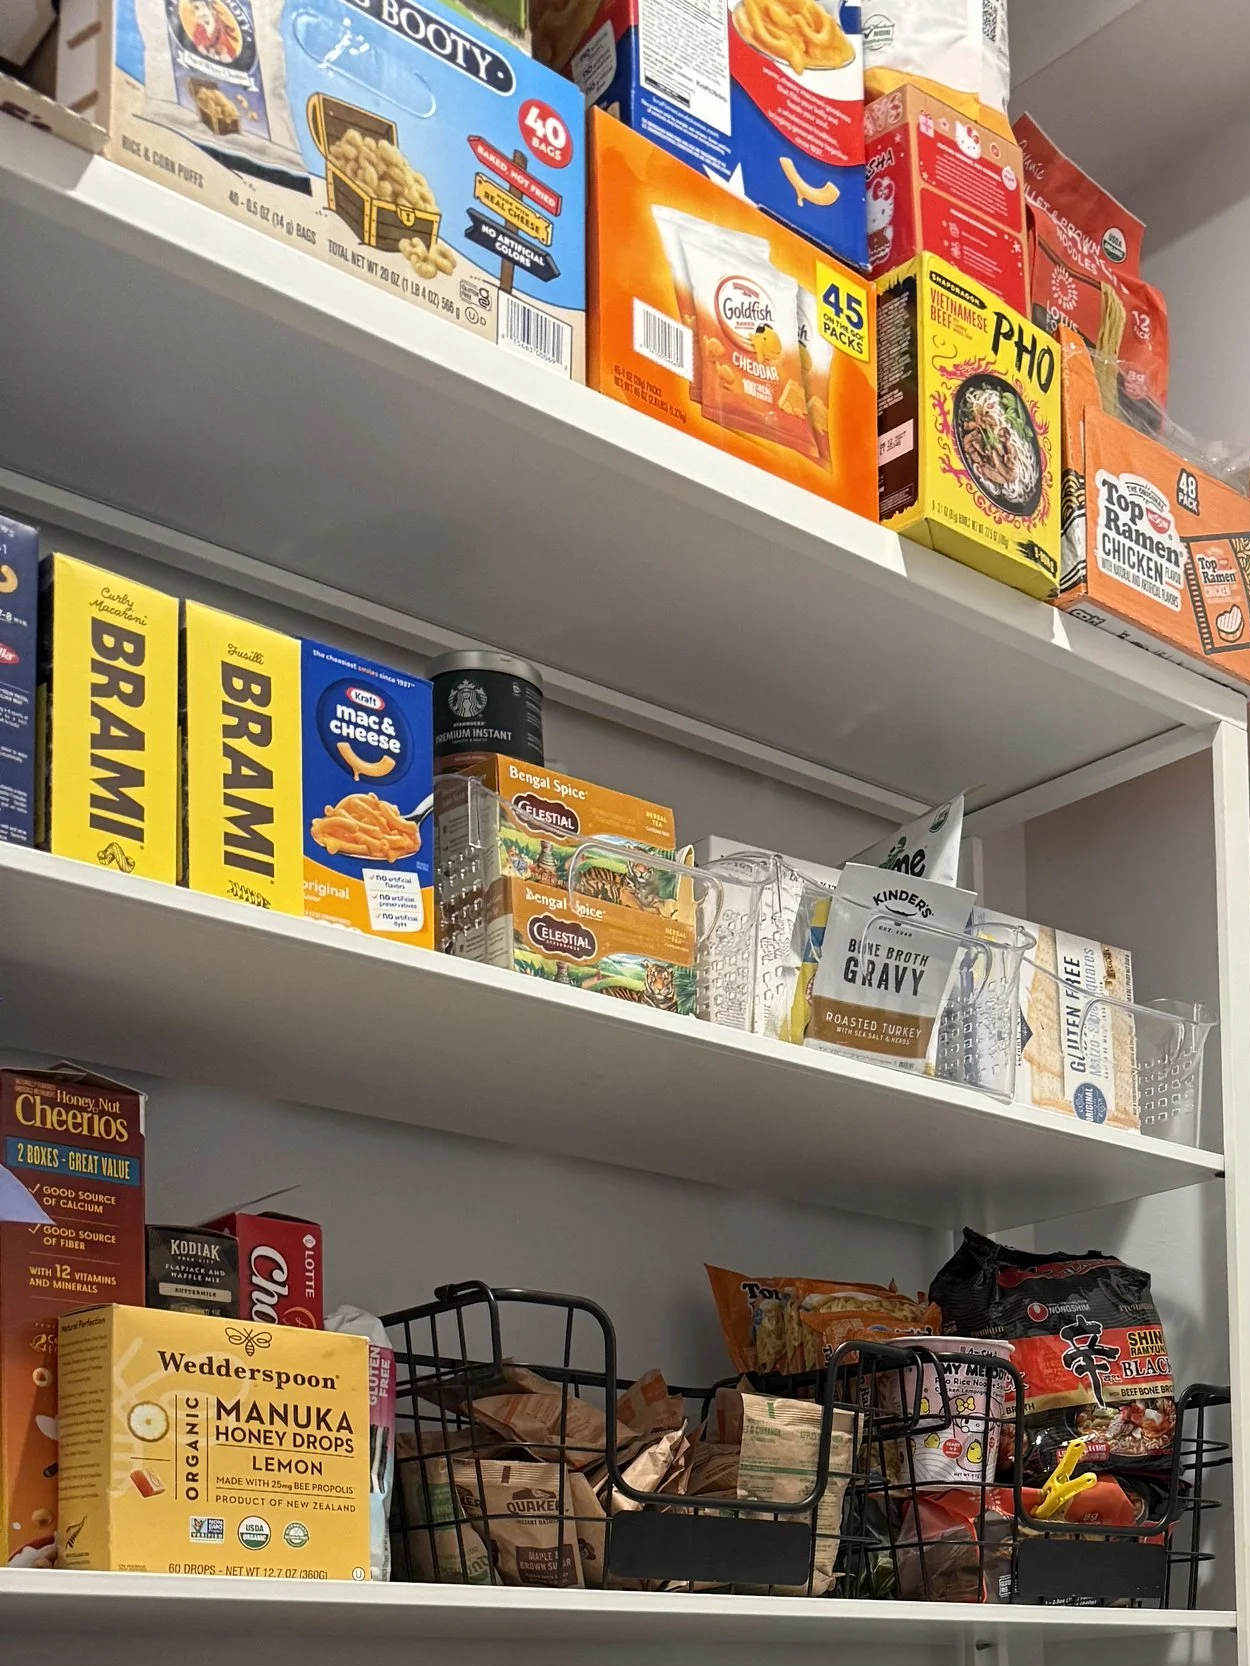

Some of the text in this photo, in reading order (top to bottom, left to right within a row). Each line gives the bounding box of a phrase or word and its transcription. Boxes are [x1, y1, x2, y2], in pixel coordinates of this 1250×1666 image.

[382, 2, 489, 84] BOOTY
[525, 105, 566, 149] 40
[122, 135, 142, 155] RICE
[153, 153, 176, 175] CORN
[178, 165, 204, 189] PUFFS
[532, 136, 561, 161] BAGS
[495, 242, 531, 267] COLORS
[1056, 227, 1097, 275] NOODLES
[723, 298, 774, 323] Goldfish
[823, 283, 864, 331] 45
[930, 288, 988, 333] VIETNAMESE
[930, 304, 952, 329] BEEF
[824, 324, 863, 355] PACKS
[993, 312, 1054, 394] PHO
[732, 352, 779, 381] CHEDDAR
[1179, 472, 1197, 499] 48
[1102, 479, 1144, 526] Top
[1178, 493, 1199, 513] PACK
[1104, 505, 1180, 568] Ramen
[1101, 532, 1182, 586] CHICKEN FLAVOR
[1198, 557, 1218, 572] Top
[1202, 570, 1236, 584] Ramen
[355, 691, 377, 707] Kraft
[89, 616, 146, 842] BRAMI
[336, 704, 396, 735] mac &
[472, 728, 512, 741] INSTANT
[220, 659, 275, 878] BRAMI
[509, 766, 586, 799] Bengal Spice
[873, 889, 933, 919] KINDER'S
[532, 922, 591, 950] CELESTIAL
[887, 947, 929, 966] BROTH
[844, 957, 925, 996] GRAVY
[826, 1011, 922, 1039] ROASTED TURKEY
[56, 1090, 121, 1113] Honey Nut
[15, 1093, 129, 1142] Cheerios
[17, 1143, 130, 1180] 2 BOXES GREAT VALUE
[43, 1186, 117, 1205] GOOD SOURCE
[43, 1196, 103, 1214] OF CALCIUM
[43, 1226, 117, 1244] GOOD SOURCE
[43, 1236, 86, 1250] OF FIBER
[170, 1239, 221, 1261] KODIAK
[29, 1264, 117, 1286] WITH 12 VITAMINS
[165, 1263, 226, 1276] FLAPJACK AND
[170, 1271, 220, 1283] WAFFLE MIX
[304, 1250, 315, 1298] LOTTE
[29, 1277, 98, 1294] AND MINERALS
[1049, 1303, 1090, 1314] NONGSHIM
[1127, 1331, 1163, 1346] SHIN
[157, 1350, 336, 1390] Wedderspoon
[216, 1397, 353, 1434] MANUKA
[185, 1397, 199, 1501] ORGANIC
[216, 1425, 353, 1454] HONEY DROPS
[252, 1456, 323, 1476] LEMON
[216, 1477, 353, 1494] MADE WITH 25mg BEE PROPOLIS
[216, 1495, 356, 1513] PRODUCT OF NEW ZEALAND
[245, 1524, 264, 1532] USDA
